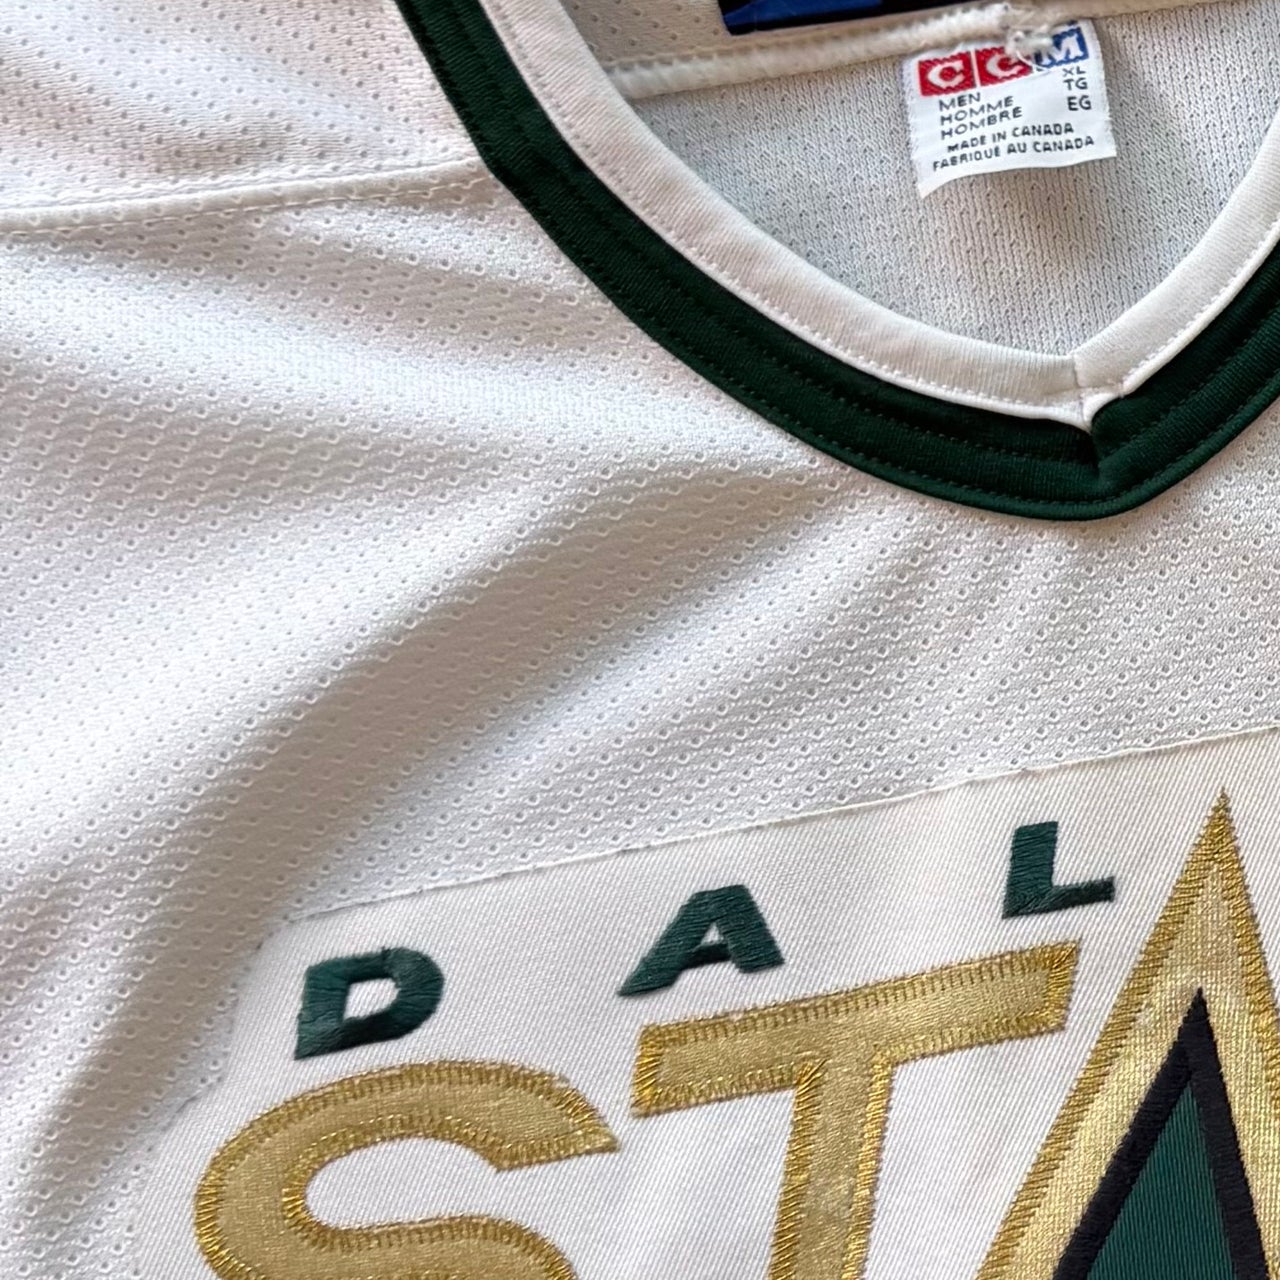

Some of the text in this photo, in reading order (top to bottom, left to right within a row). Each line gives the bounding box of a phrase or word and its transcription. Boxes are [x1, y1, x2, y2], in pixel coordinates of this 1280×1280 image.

[1062, 66, 1087, 78] XL
[1064, 77, 1088, 91] TG
[939, 92, 981, 112] MEN
[940, 96, 1014, 126] HOMME
[1067, 95, 1092, 111] EG
[941, 106, 1023, 140] HOMBRE
[948, 123, 1074, 153] MADE IN CANADA
[1007, 142, 1027, 154] AU
[1033, 136, 1094, 154] CANADA
